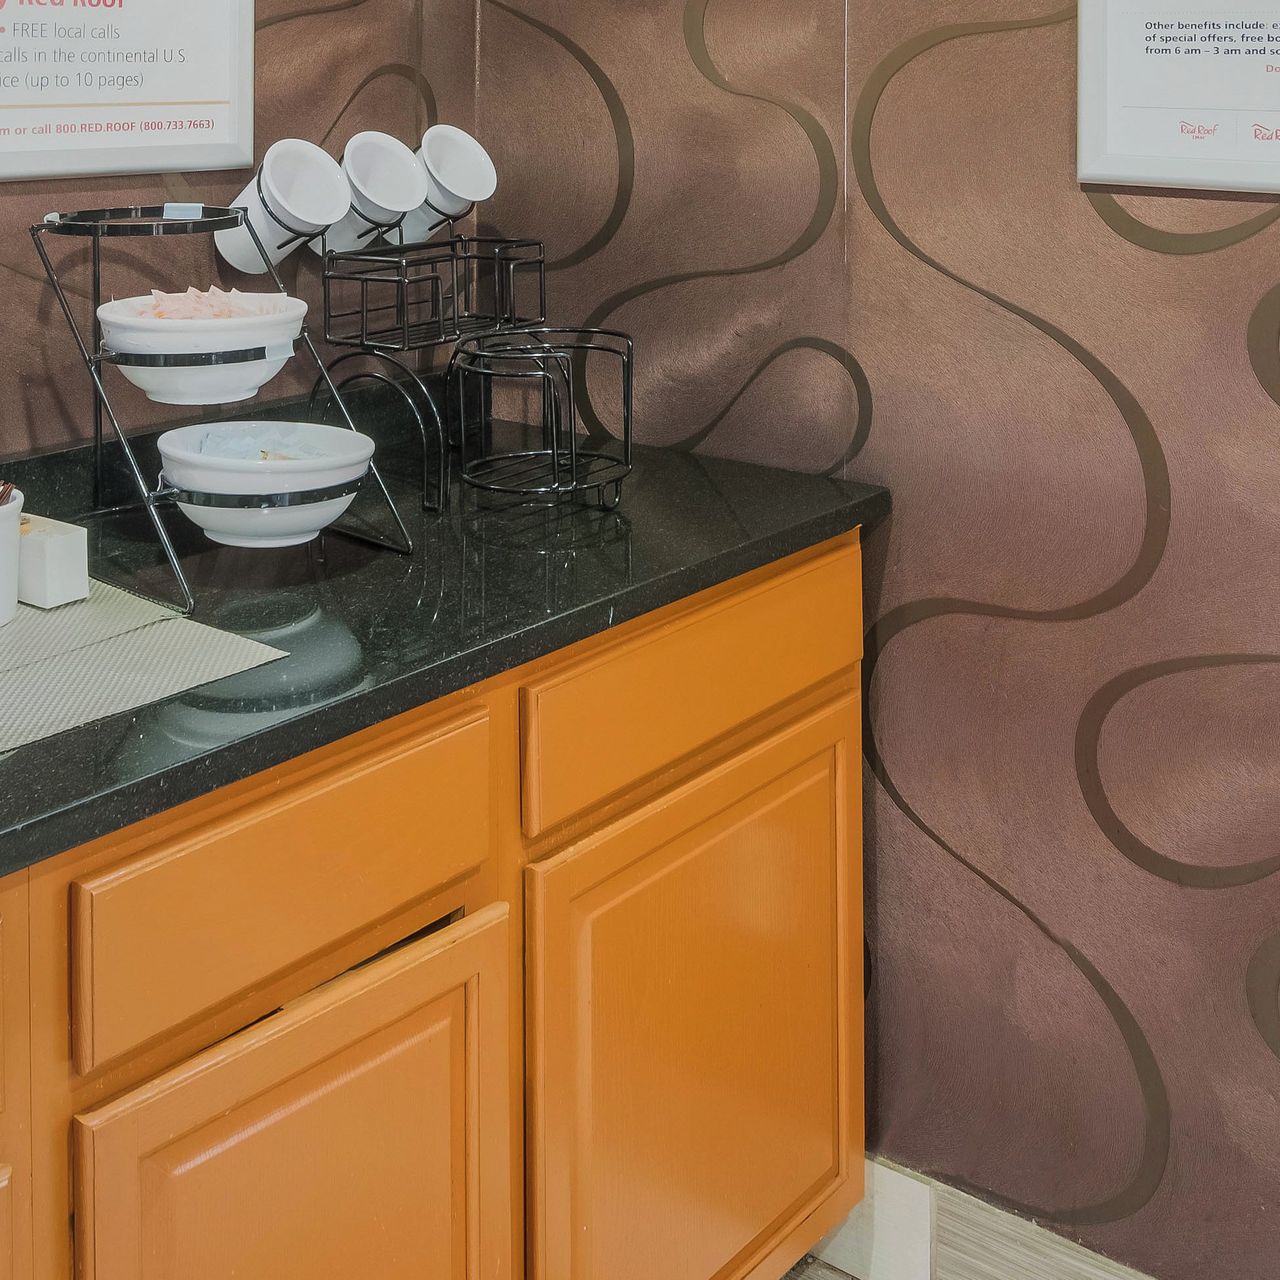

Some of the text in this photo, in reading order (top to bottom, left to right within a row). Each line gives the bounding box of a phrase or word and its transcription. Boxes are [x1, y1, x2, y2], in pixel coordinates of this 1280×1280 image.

[13, 23, 48, 38] FREE
[54, 22, 86, 39] local
[91, 24, 120, 39] calls
[1145, 21, 1174, 30] Other
[1178, 20, 1221, 30] benefits
[1160, 33, 1197, 44] special
[1241, 33, 1264, 43] free
[34, 48, 47, 63] in
[53, 48, 76, 63] the
[80, 48, 158, 63] continental
[163, 48, 189, 63] U.S.
[24, 72, 49, 91] (up
[55, 73, 69, 88] to
[76, 72, 93, 87] 10
[98, 71, 144, 91] pages)
[32, 124, 51, 135] call
[56, 122, 136, 134] 800.RED.ROOF
[140, 119, 214, 133] (800.733.7663)
